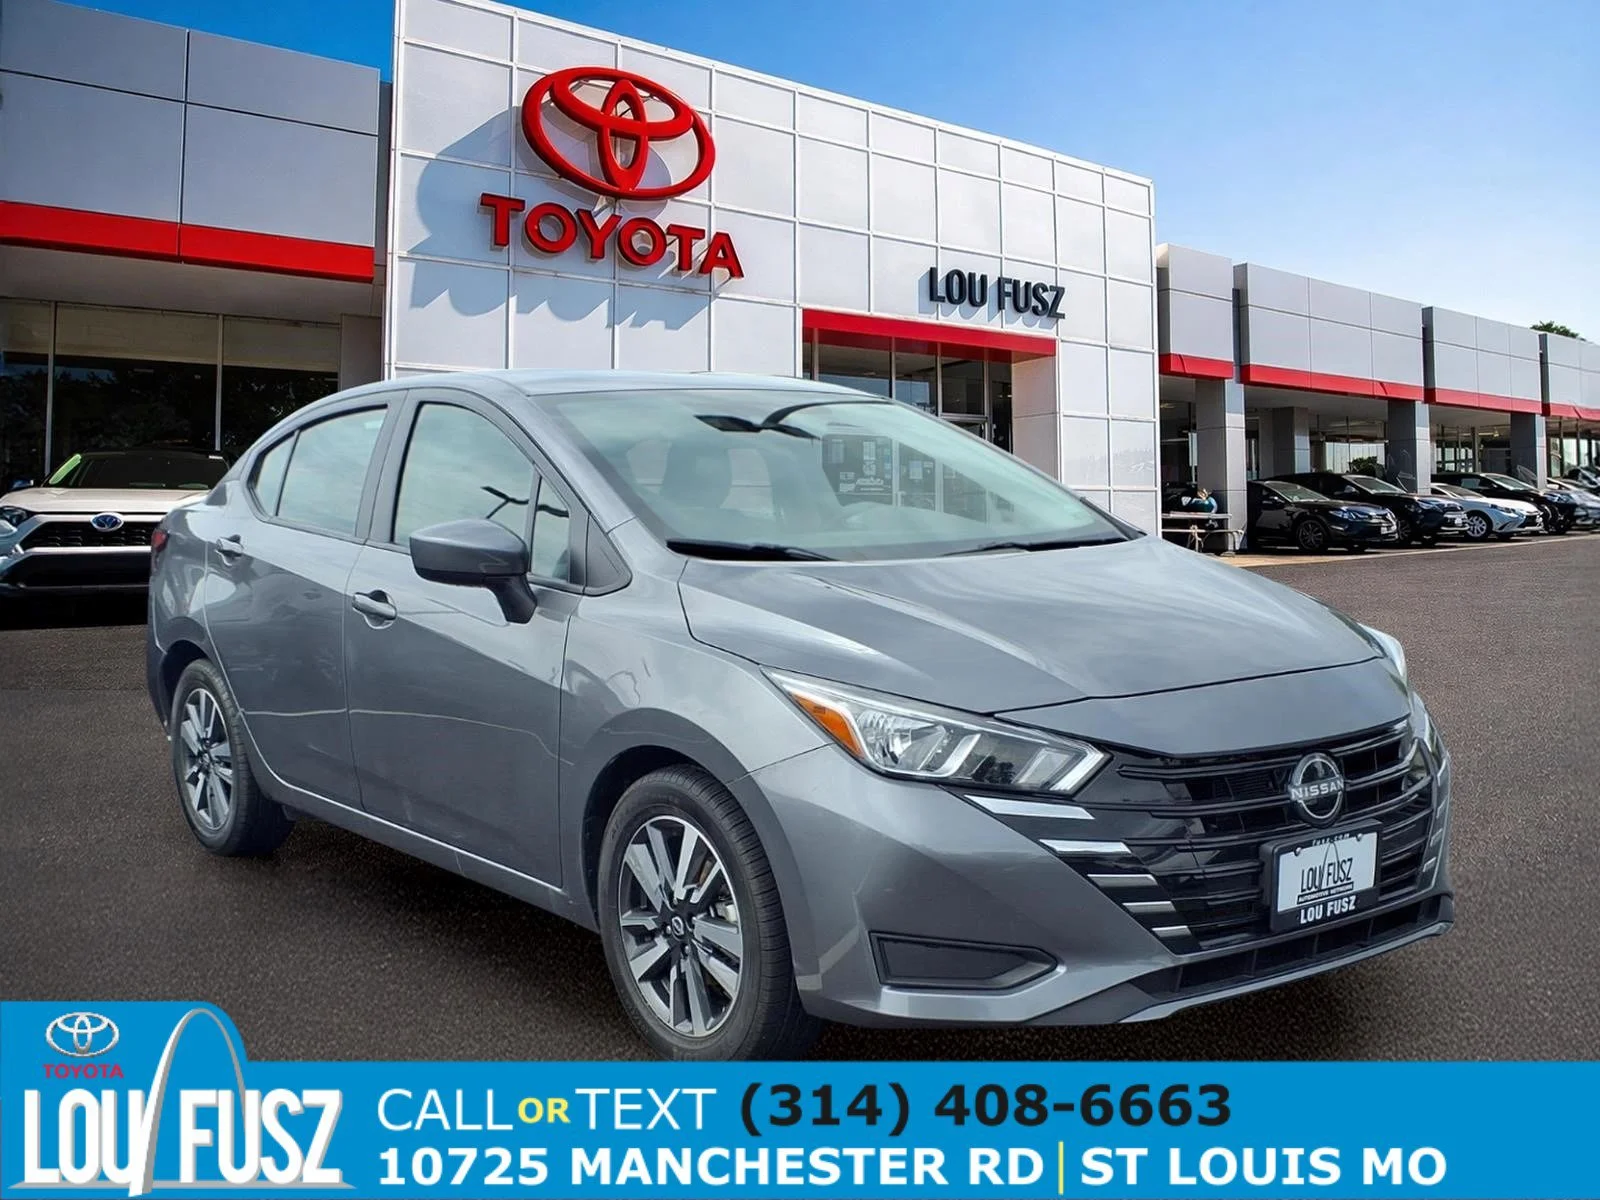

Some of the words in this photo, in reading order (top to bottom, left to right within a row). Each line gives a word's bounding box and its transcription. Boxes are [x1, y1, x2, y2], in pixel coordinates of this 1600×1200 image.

[480, 192, 745, 279] TOYOTA
[929, 266, 987, 308] LOU
[997, 276, 1066, 319] FUSZ
[1290, 780, 1344, 800] NISSAN
[1301, 866, 1322, 893] LOU
[1327, 857, 1353, 887] FUSZ
[1300, 904, 1323, 924] LOU
[1326, 895, 1357, 917] FUSZ
